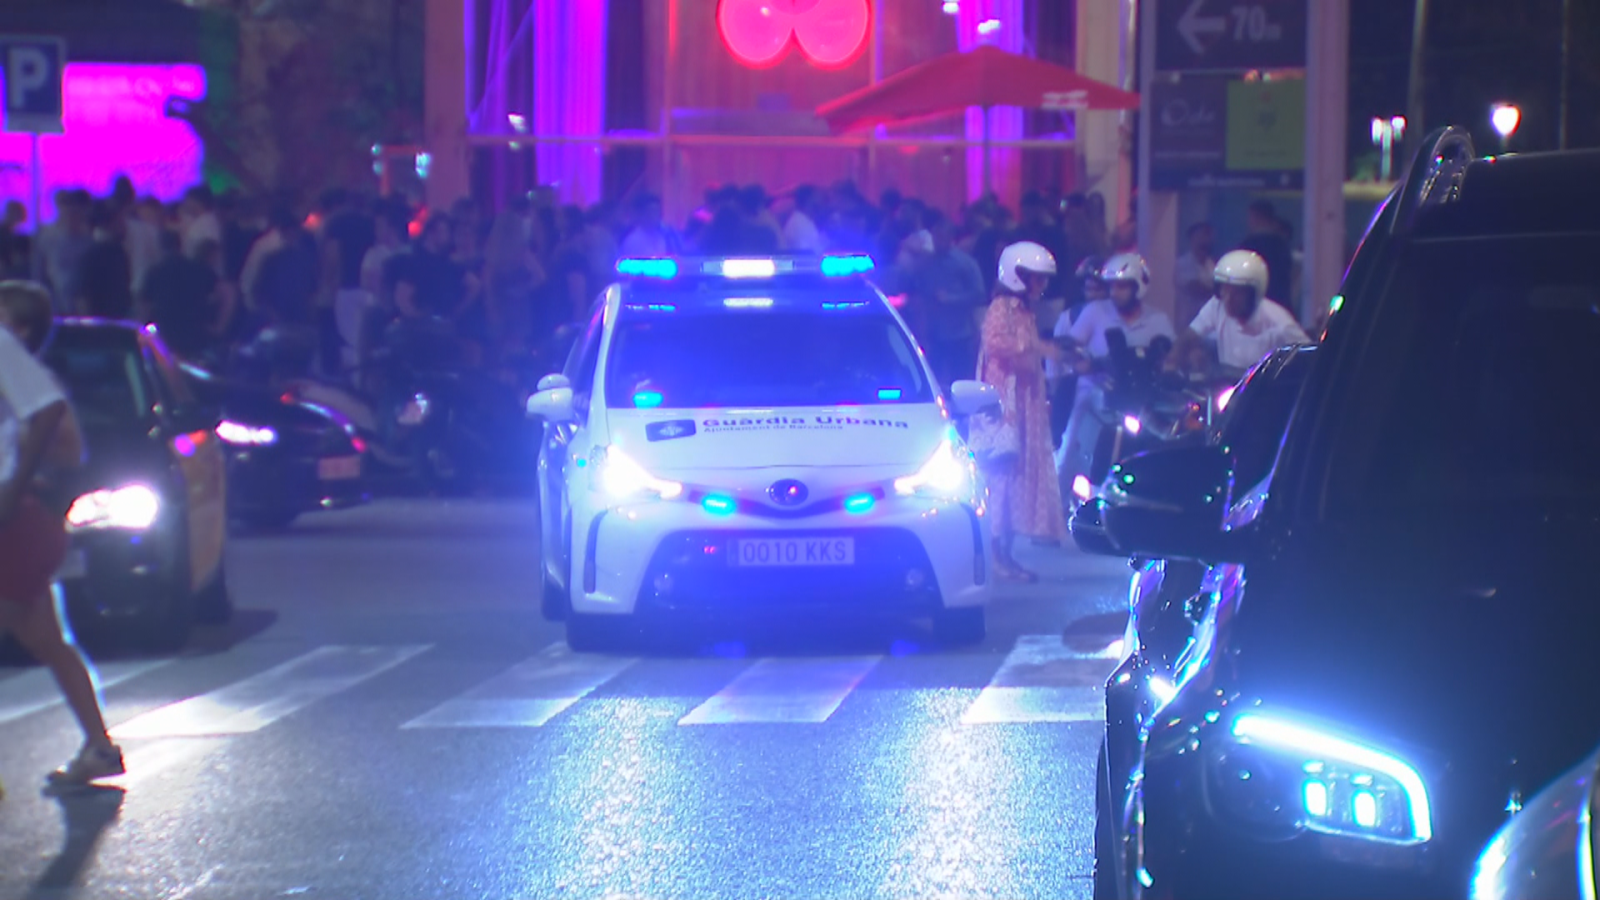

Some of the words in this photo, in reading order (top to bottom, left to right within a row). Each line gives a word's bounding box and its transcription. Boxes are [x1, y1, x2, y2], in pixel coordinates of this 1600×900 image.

[9, 48, 48, 109] P
[816, 415, 908, 429] Urbana
[743, 541, 798, 563] 0010
[805, 540, 847, 562] KKS
